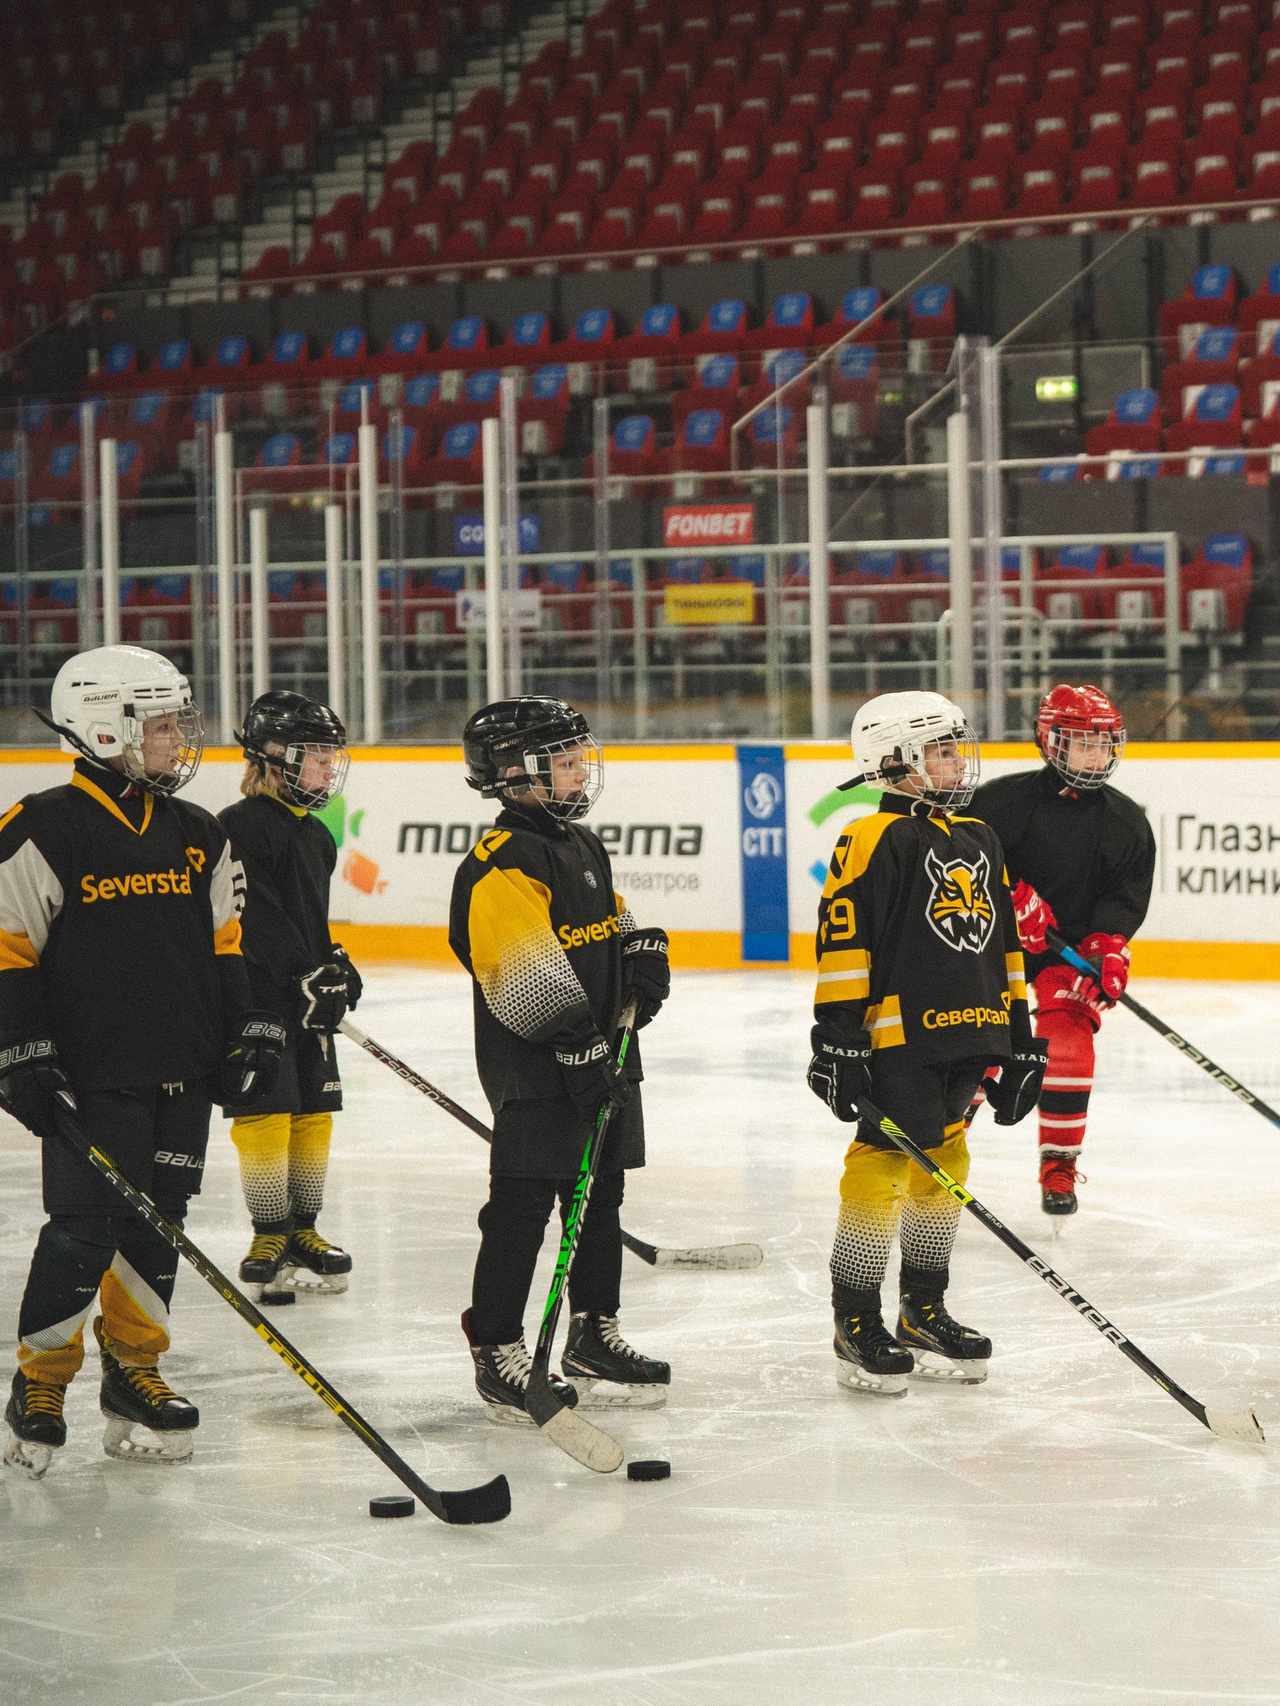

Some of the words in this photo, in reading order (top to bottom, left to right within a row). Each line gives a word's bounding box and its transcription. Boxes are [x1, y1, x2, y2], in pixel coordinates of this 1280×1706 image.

[666, 511, 752, 537] FONBET
[821, 1043, 862, 1058] MAD
[262, 1326, 340, 1411] TRUE
